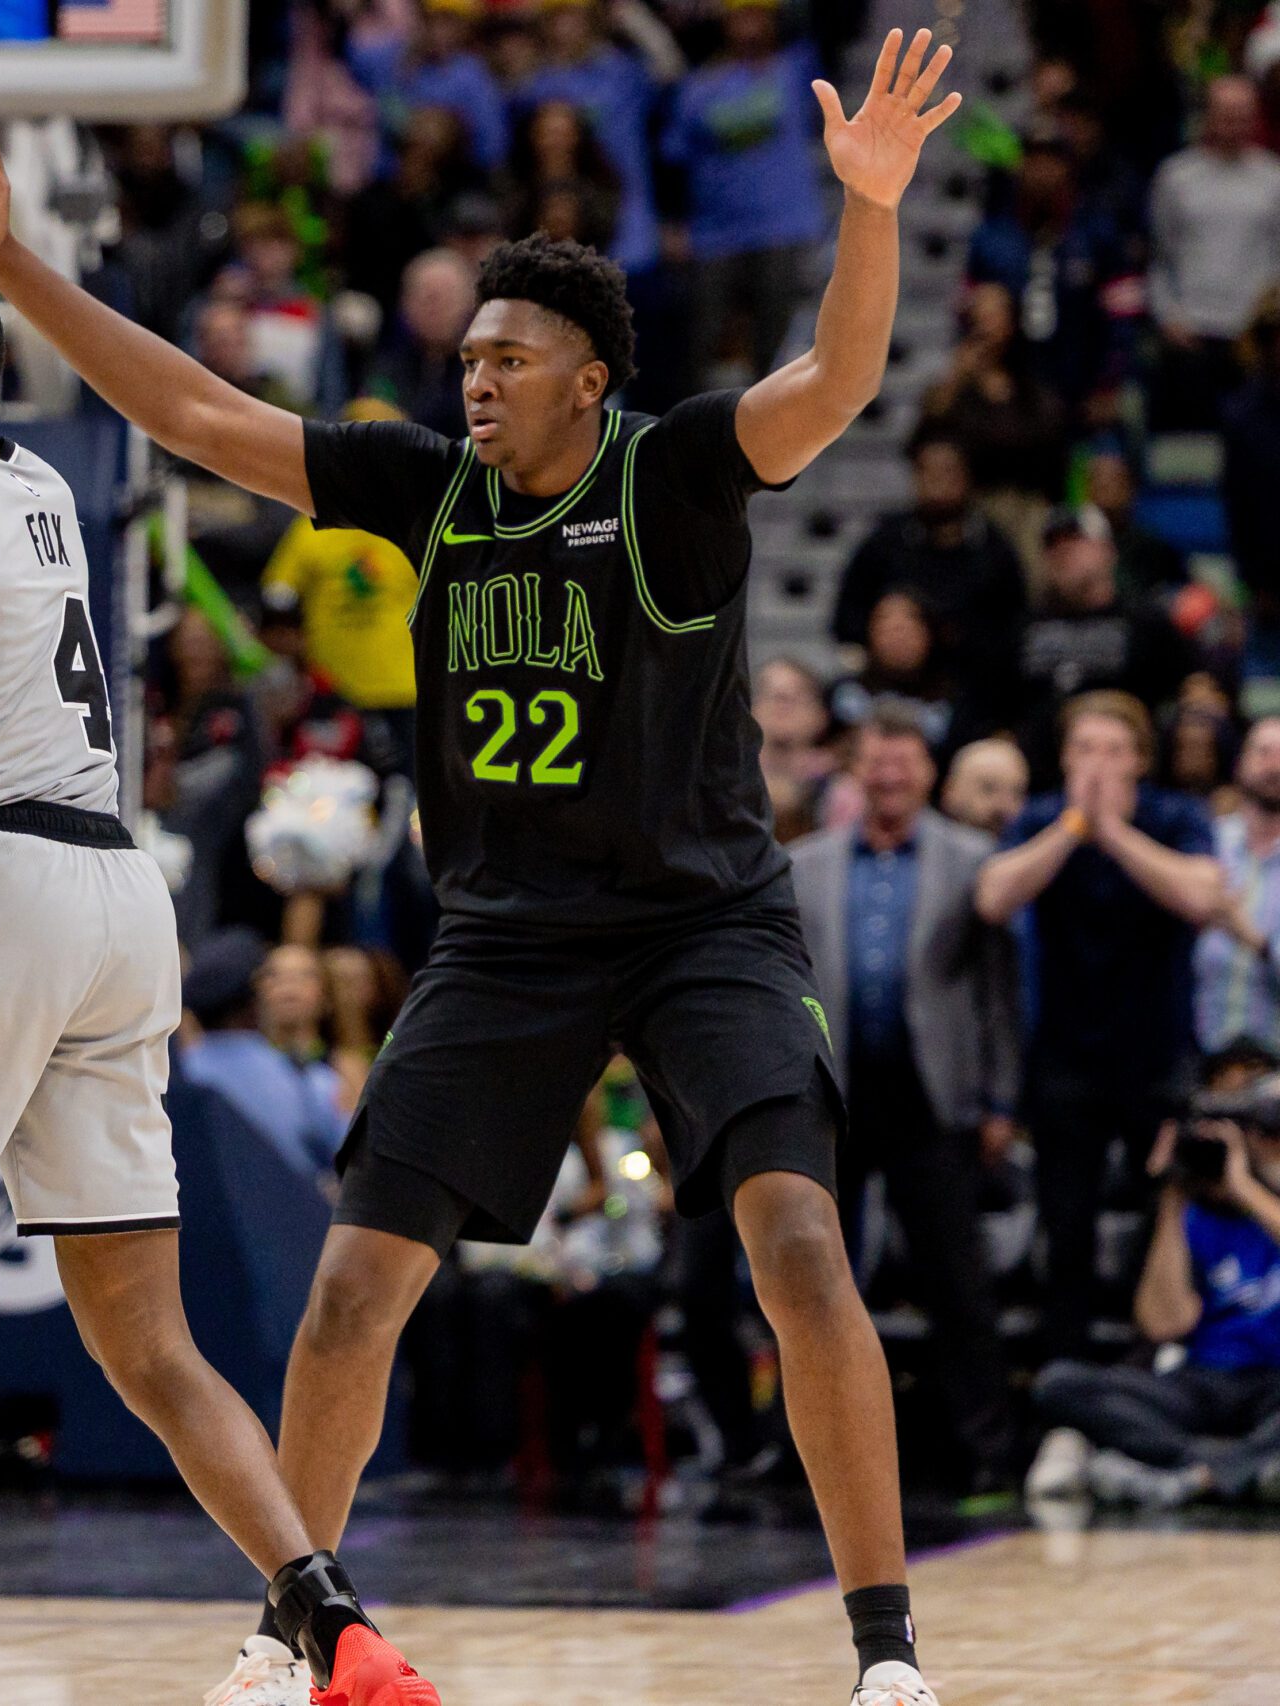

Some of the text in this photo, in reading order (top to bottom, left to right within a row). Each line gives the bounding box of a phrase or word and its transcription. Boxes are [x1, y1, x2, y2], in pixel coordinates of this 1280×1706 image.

[25, 511, 71, 567] FOX
[562, 517, 619, 538] NEWAGE
[567, 533, 616, 548] PRODUCTS
[448, 572, 605, 682] NOLA
[51, 590, 112, 758] 4
[466, 689, 584, 784] 22
